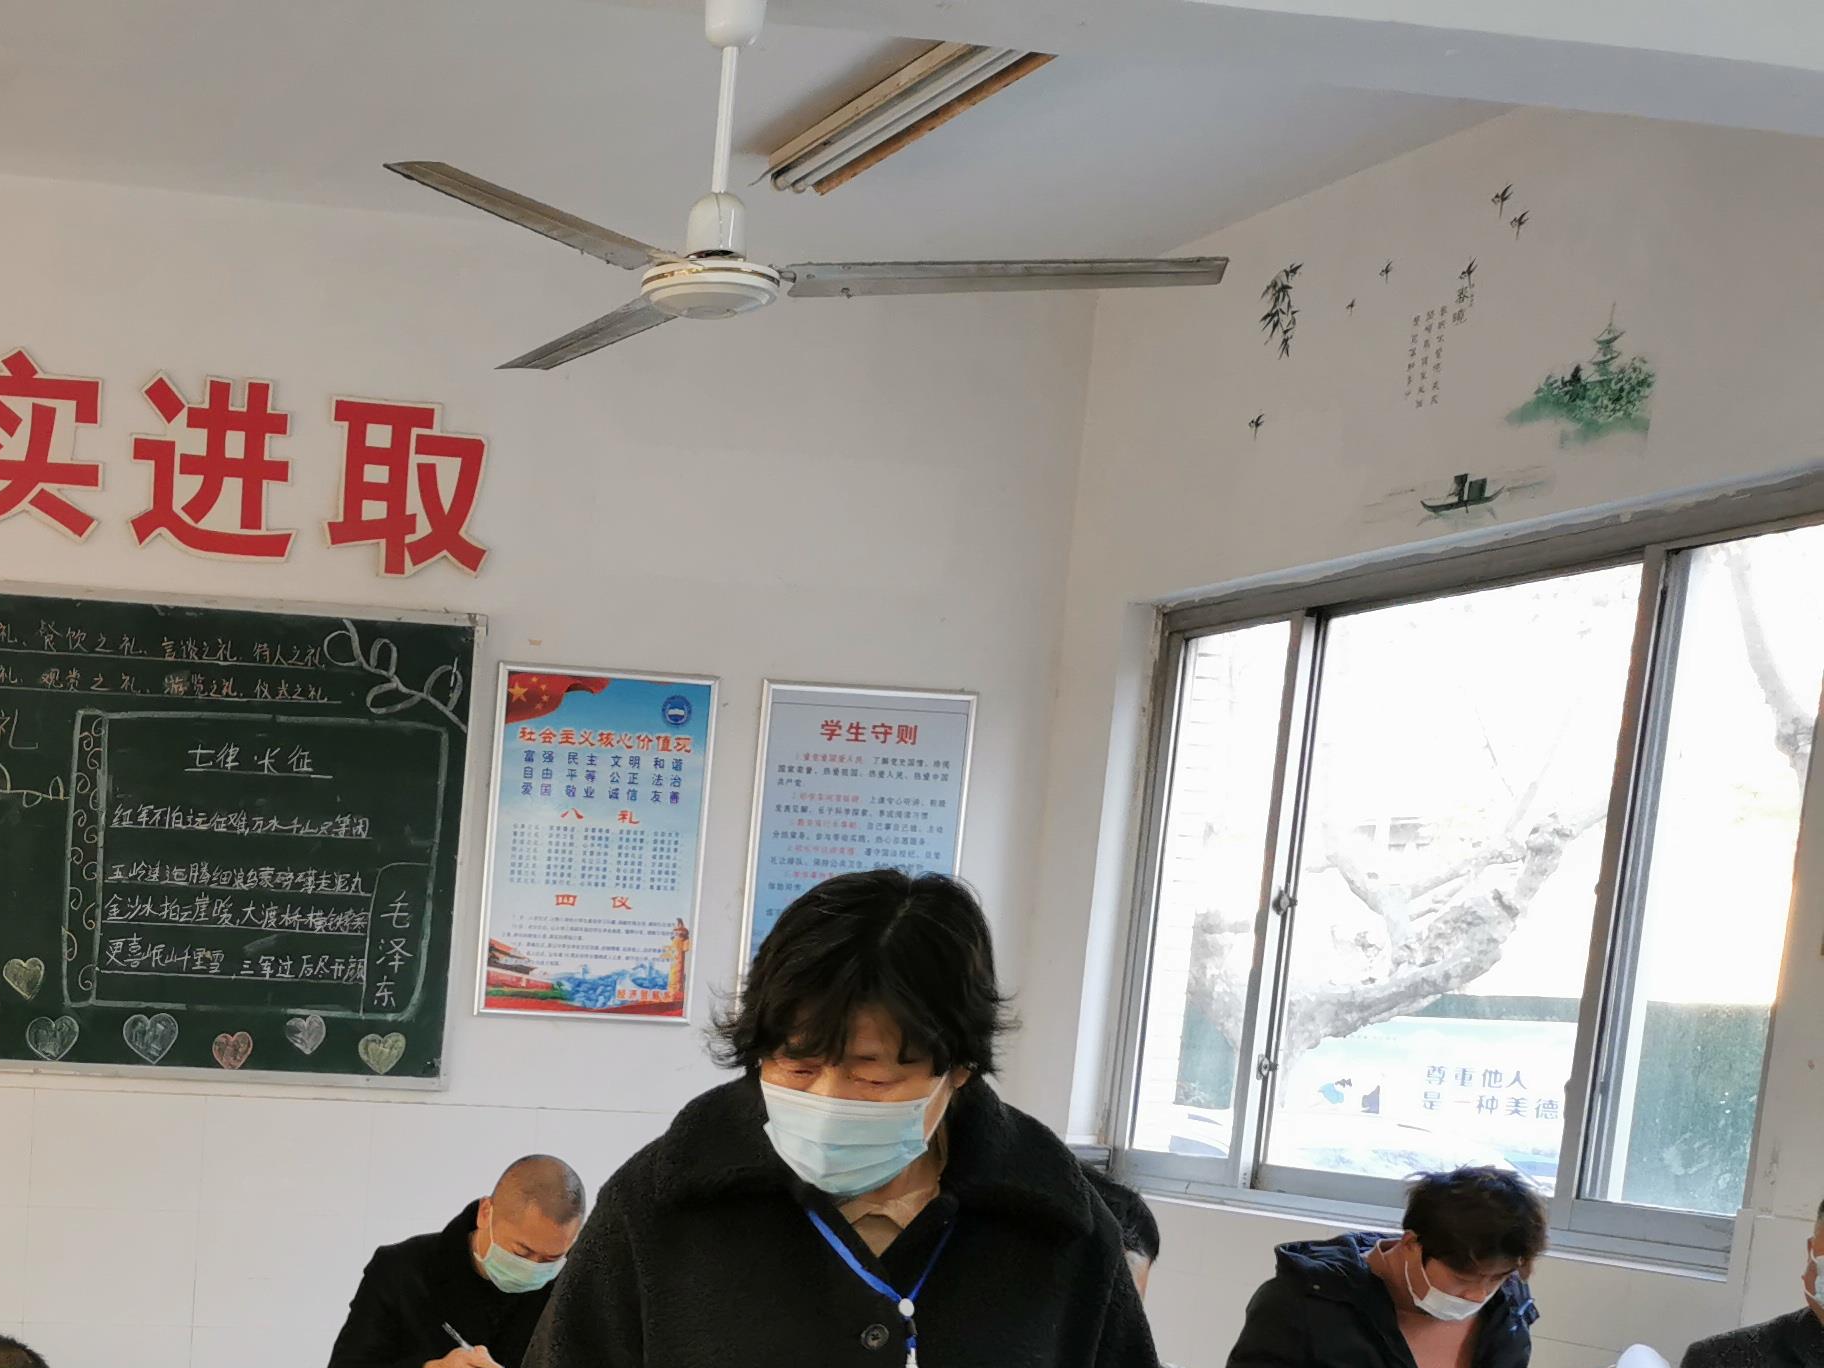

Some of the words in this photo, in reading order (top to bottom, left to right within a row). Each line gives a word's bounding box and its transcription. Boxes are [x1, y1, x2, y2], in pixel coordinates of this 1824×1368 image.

[518, 726, 692, 753] 社会主义核心价值观
[820, 719, 918, 745] 学生守则
[560, 807, 640, 825] 八礼
[555, 894, 632, 910] 四仪
[373, 891, 413, 1006] 毛泽东
[1426, 1066, 1528, 1090] 尊重他人
[1423, 1091, 1560, 1119] 是一种美德
